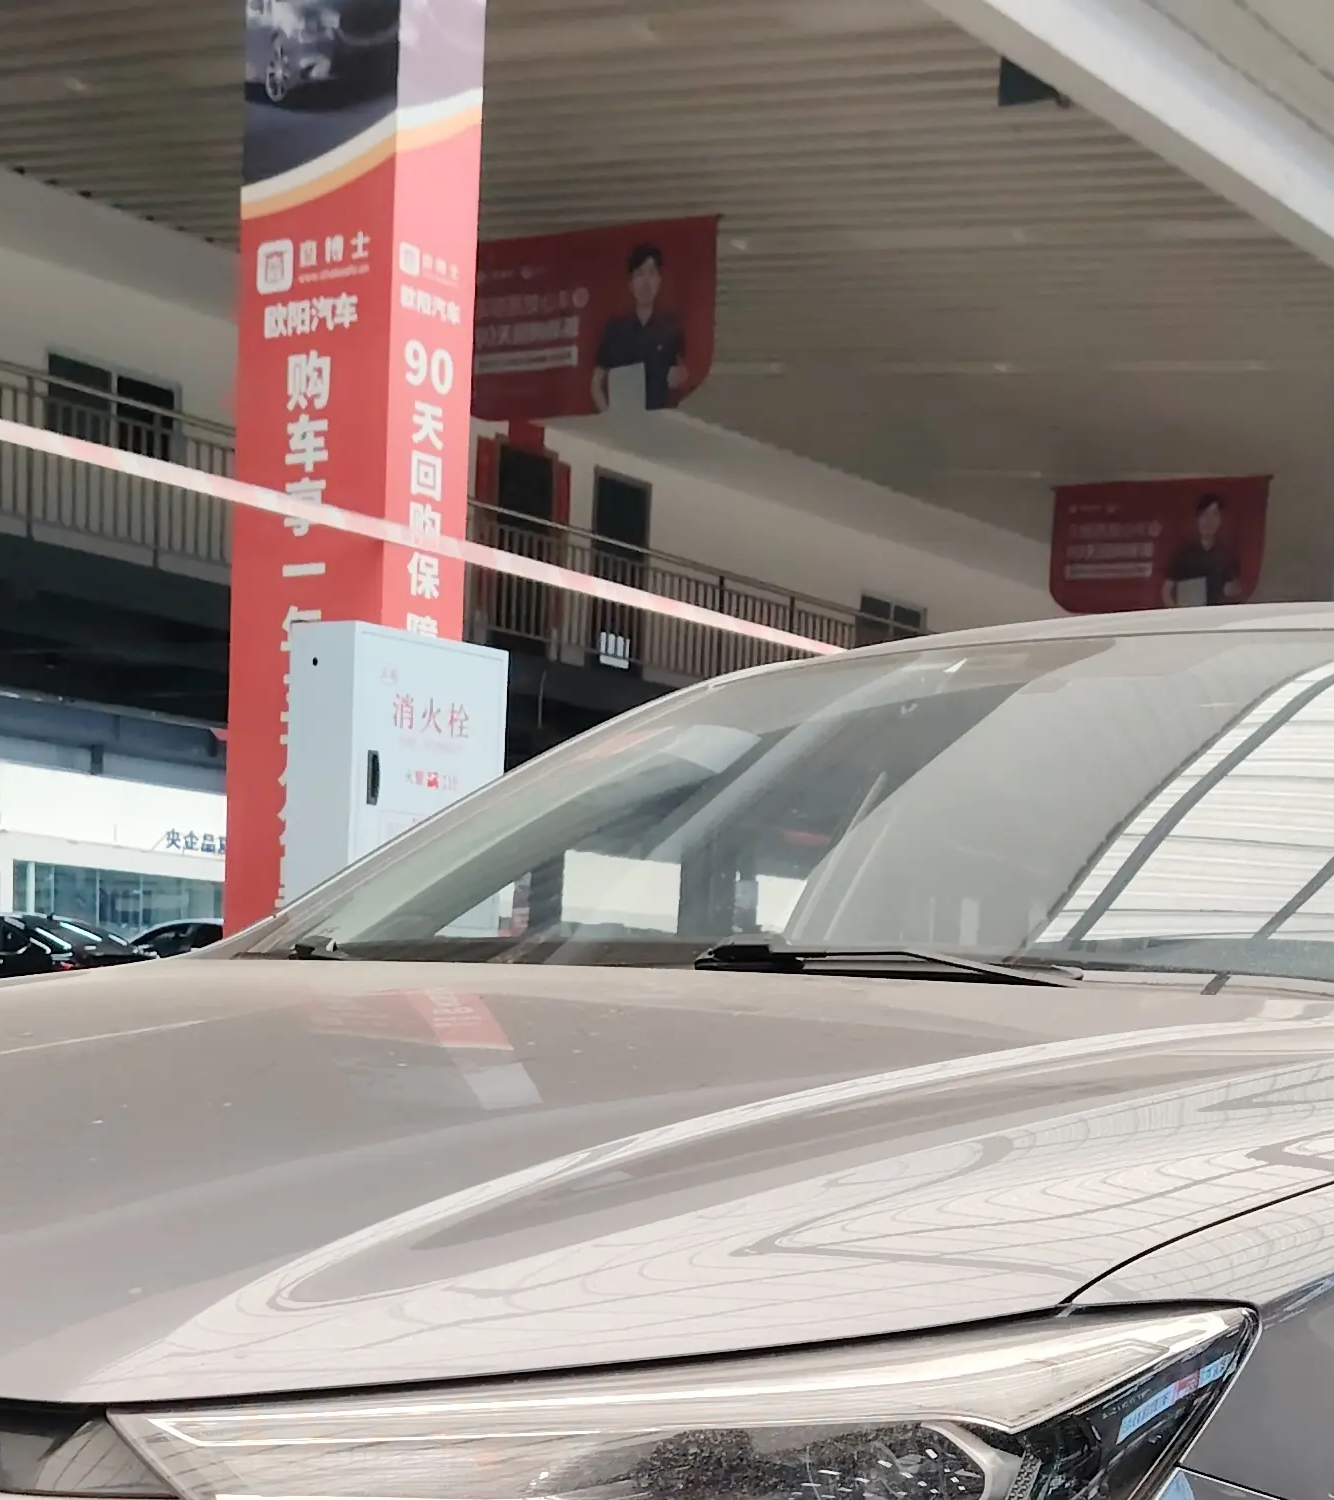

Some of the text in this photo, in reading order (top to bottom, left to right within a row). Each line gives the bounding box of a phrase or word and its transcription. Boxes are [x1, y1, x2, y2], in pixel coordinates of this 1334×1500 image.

[263, 291, 359, 339] 欧阳汽车
[392, 693, 470, 739] 消火栓
